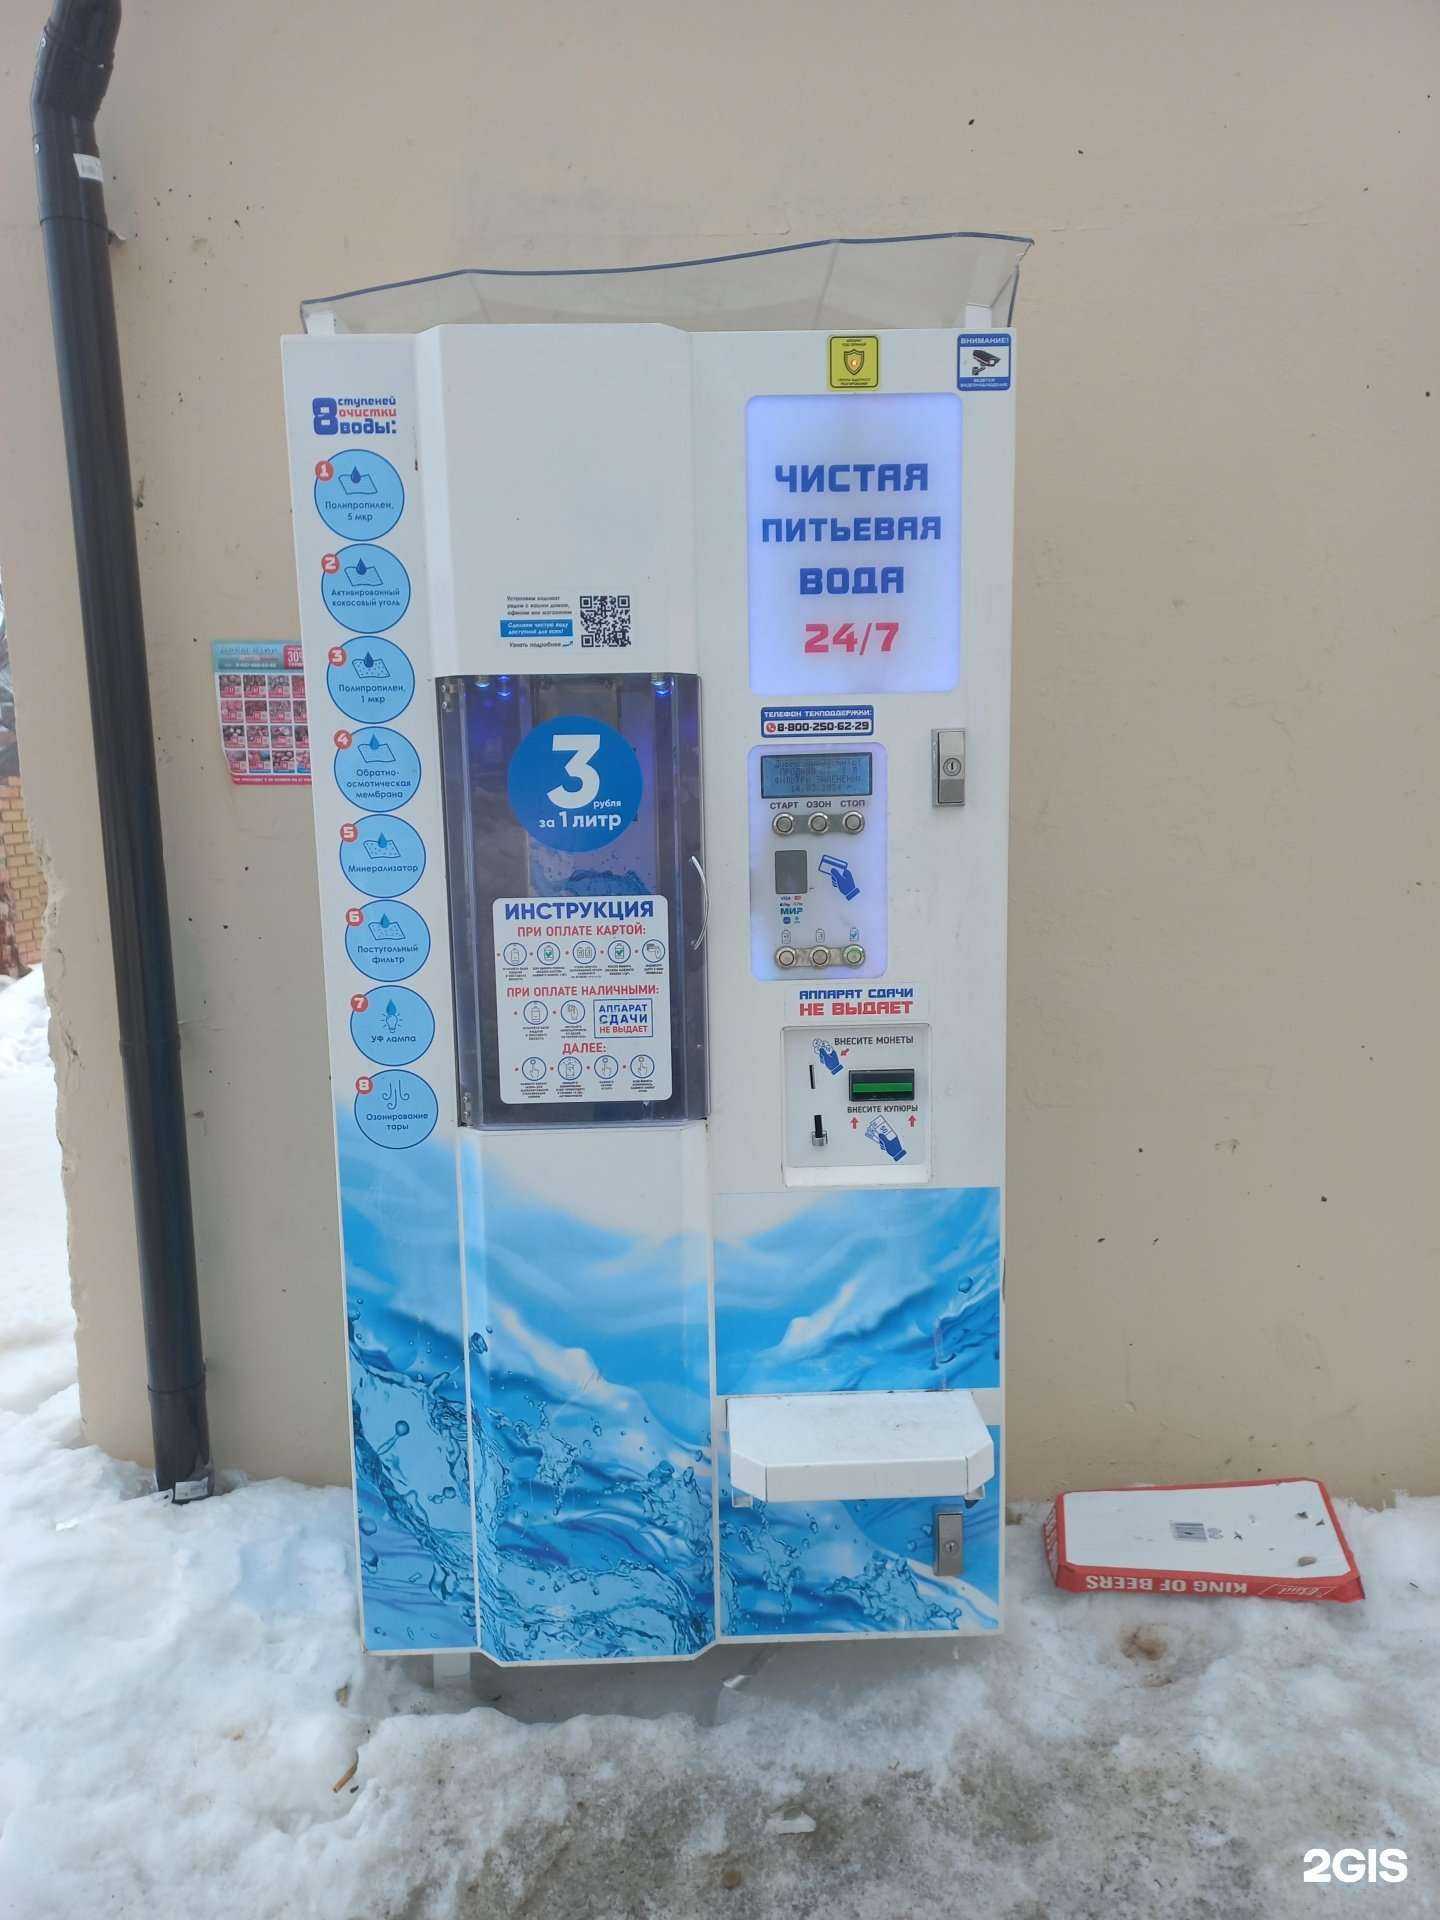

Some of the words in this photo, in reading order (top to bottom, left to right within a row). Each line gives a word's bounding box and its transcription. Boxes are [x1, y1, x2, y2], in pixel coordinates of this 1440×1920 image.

[960, 336, 1009, 344] ВНИМАНИЕ!
[338, 396, 396, 407] ступеней
[312, 397, 338, 435] 8
[339, 408, 397, 417] очистки
[340, 418, 397, 434] воды:
[321, 464, 328, 477] 1
[775, 463, 928, 493] ЧИСТАЯ
[325, 501, 394, 510] Полипропилен,
[355, 514, 373, 522] мкр
[762, 516, 941, 542] ПИТЬЕВАЯ
[325, 558, 336, 569] 2
[800, 567, 904, 594] ВОДА
[331, 588, 400, 596] Активированный
[805, 623, 899, 655] 24/7
[332, 650, 342, 662] 3
[339, 684, 406, 693] Полипропилен,
[368, 696, 385, 704] мкр
[777, 721, 869, 731] 8-800-250-62-29
[338, 734, 348, 745] 4
[356, 769, 399, 777] Обратно-
[547, 734, 600, 809] 3
[356, 791, 403, 799] мембрана
[593, 799, 621, 809] рубля
[770, 802, 799, 810] СТАРТ
[539, 819, 555, 828] за
[559, 811, 567, 827] 1
[572, 814, 621, 830] литр
[343, 827, 354, 838] 5
[348, 865, 418, 874] Минерализатор
[505, 901, 654, 920] ИНСТРУКЦИЯ
[350, 912, 359, 923] 6
[518, 927, 541, 937] ПРИ
[546, 925, 592, 936] ОПЛАТЕ
[597, 922, 646, 936] КАРТОЙ:
[357, 945, 418, 953] Постугольный
[372, 956, 405, 964] фильтр
[507, 987, 529, 997] ПРИ
[533, 986, 577, 997] ОПЛАТЕ
[582, 985, 659, 996] НАЛИЧНЫМИ:
[800, 989, 863, 1000] АППАРАТ
[868, 988, 913, 998] СДАЧИ
[355, 998, 364, 1008] 7
[599, 1004, 647, 1013] АППАРАТ
[800, 1003, 824, 1016] НЕ
[832, 1001, 913, 1016] ВЫДАЕТ
[600, 1014, 648, 1024] СДАЧИ
[612, 1025, 648, 1033] ВЫДАЕТ
[371, 1035, 384, 1043] УФ
[834, 1037, 873, 1045] ВНЕСИТЕ
[876, 1036, 914, 1044] МОНЕТЫ
[562, 1042, 606, 1055] ДАЛЕЕ:
[359, 1080, 369, 1090] 8
[366, 1112, 428, 1121] Озонирование
[1086, 1575, 1152, 1590] BEERS
[1160, 1579, 1186, 1592] OF
[1193, 1581, 1248, 1593] KING
